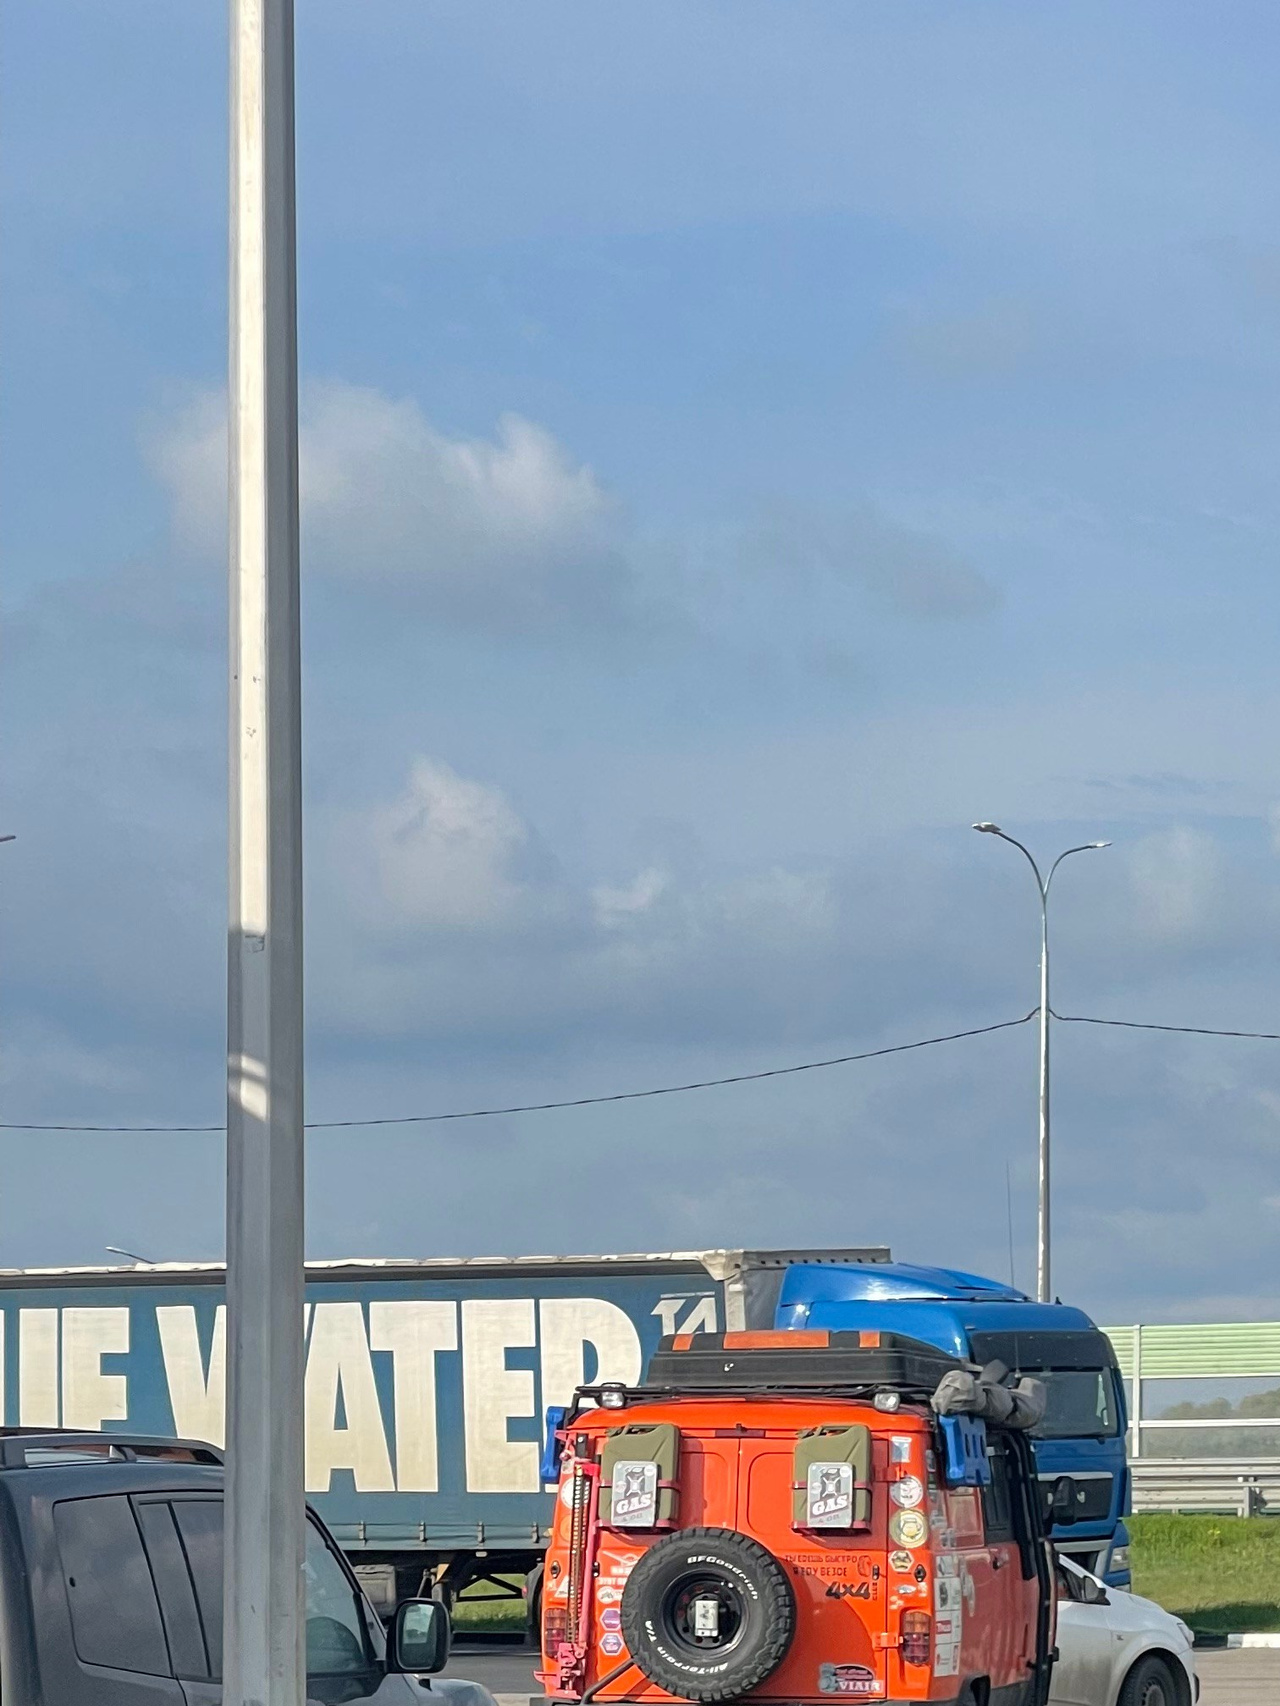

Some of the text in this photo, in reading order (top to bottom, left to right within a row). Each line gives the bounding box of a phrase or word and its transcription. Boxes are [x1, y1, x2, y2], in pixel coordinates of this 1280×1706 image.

[616, 1493, 651, 1514] GAS
[812, 1494, 848, 1515] GAS
[687, 1555, 758, 1600] BFGoodrich
[657, 1646, 728, 1674] All-Terrain
[839, 1681, 880, 1691] VIAIR
